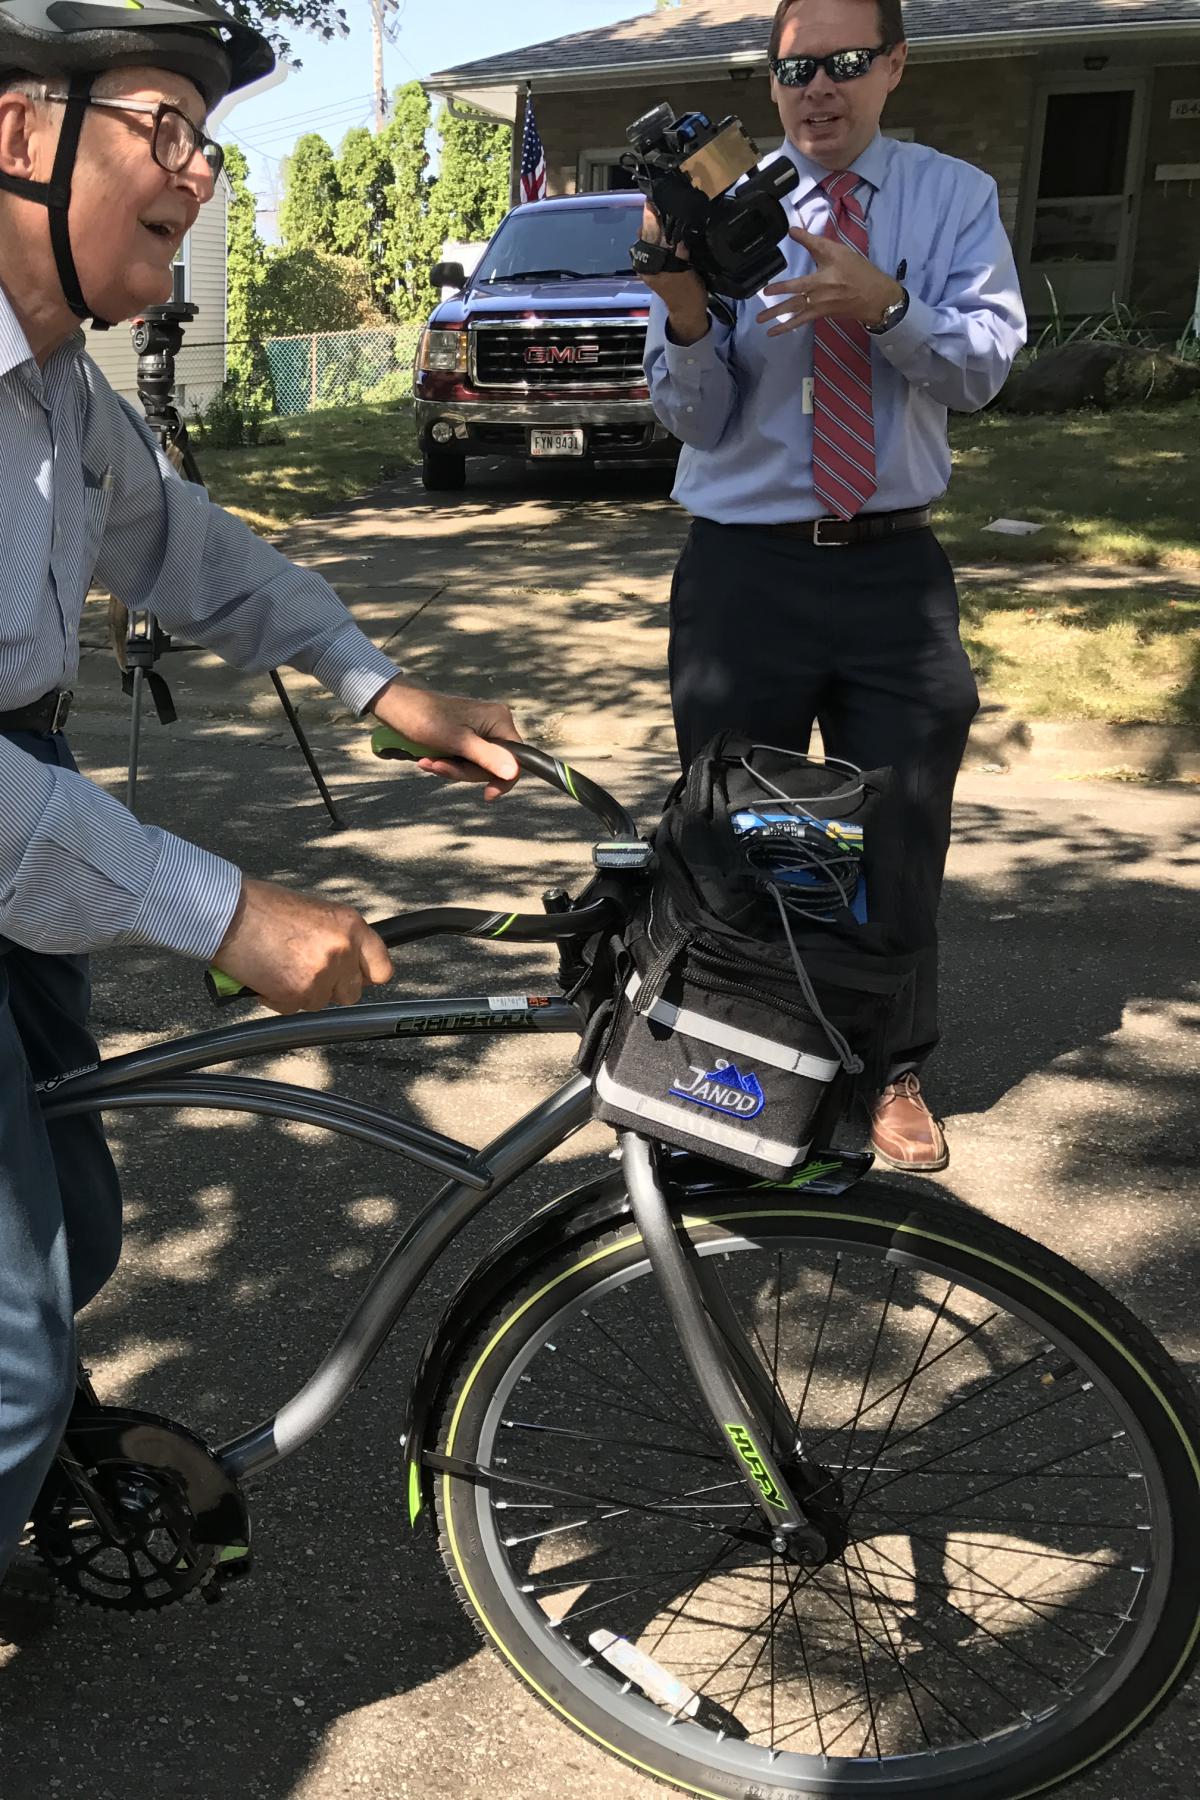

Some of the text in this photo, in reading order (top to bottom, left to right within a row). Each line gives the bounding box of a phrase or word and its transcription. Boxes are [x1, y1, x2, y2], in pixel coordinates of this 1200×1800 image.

[524, 345, 599, 364] GMC
[534, 436, 578, 449] FYN 9431
[673, 1065, 756, 1111] JANDD
[724, 1423, 789, 1511] HUFFY
